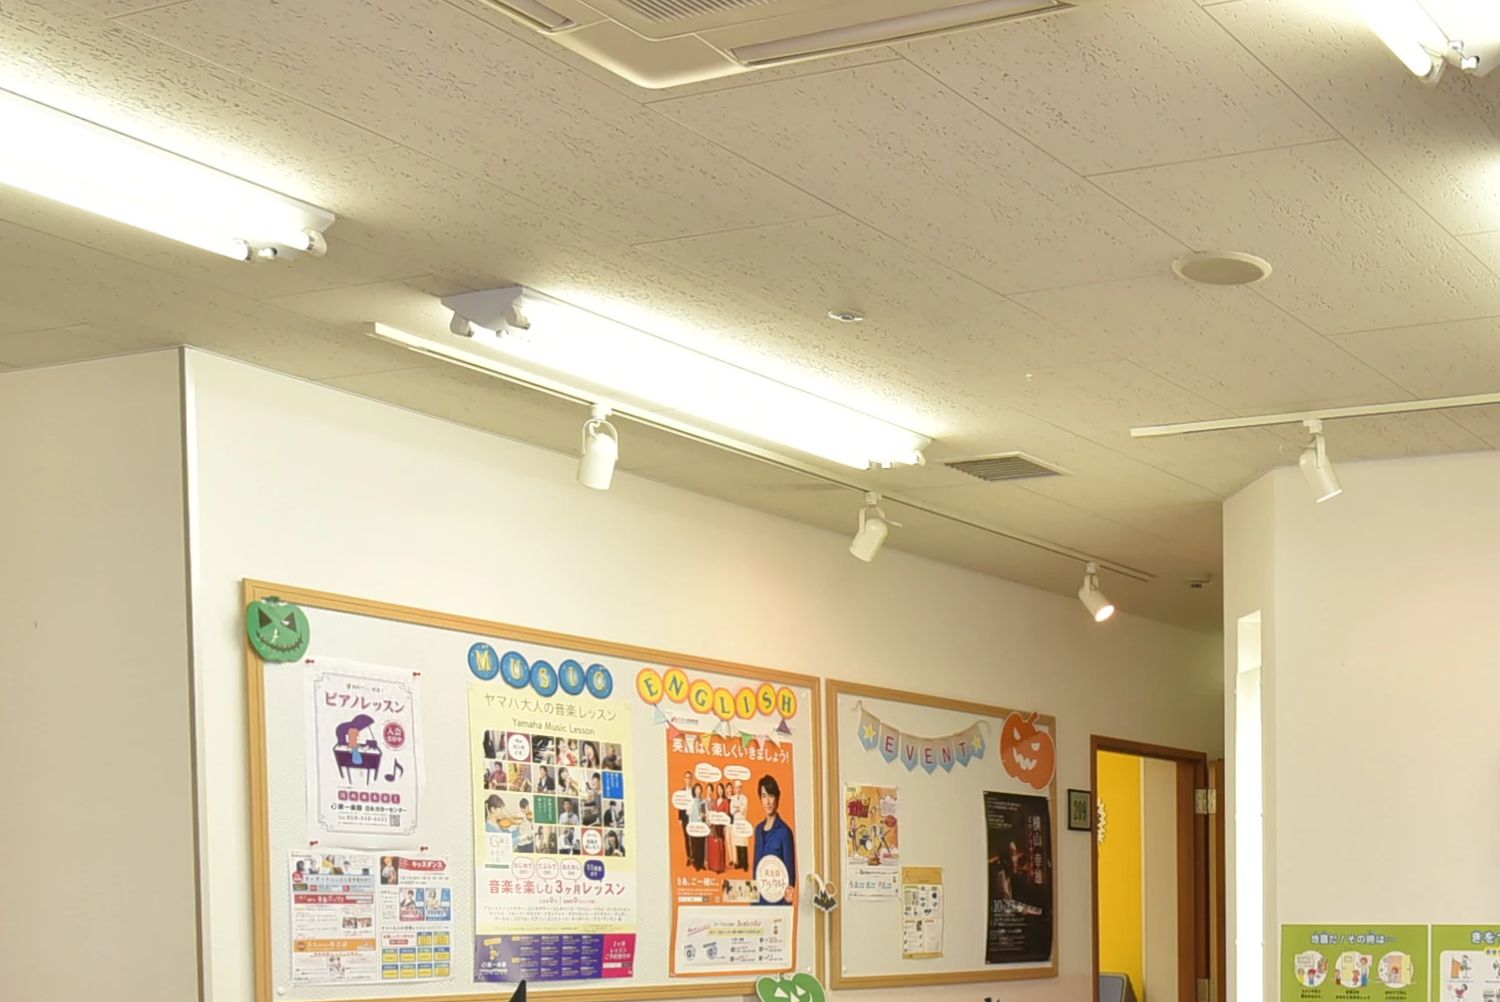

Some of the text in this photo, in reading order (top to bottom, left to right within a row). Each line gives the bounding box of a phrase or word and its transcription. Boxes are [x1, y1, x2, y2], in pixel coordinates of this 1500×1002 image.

[475, 650, 606, 691] MUSIC
[325, 692, 405, 713] ピアノレッスン
[485, 693, 617, 722] ヤマハ大人の音楽レッスン
[644, 676, 791, 713] ENGLISH
[512, 718, 595, 736] Yamaha Music Lesson
[885, 735, 966, 765] EVENT
